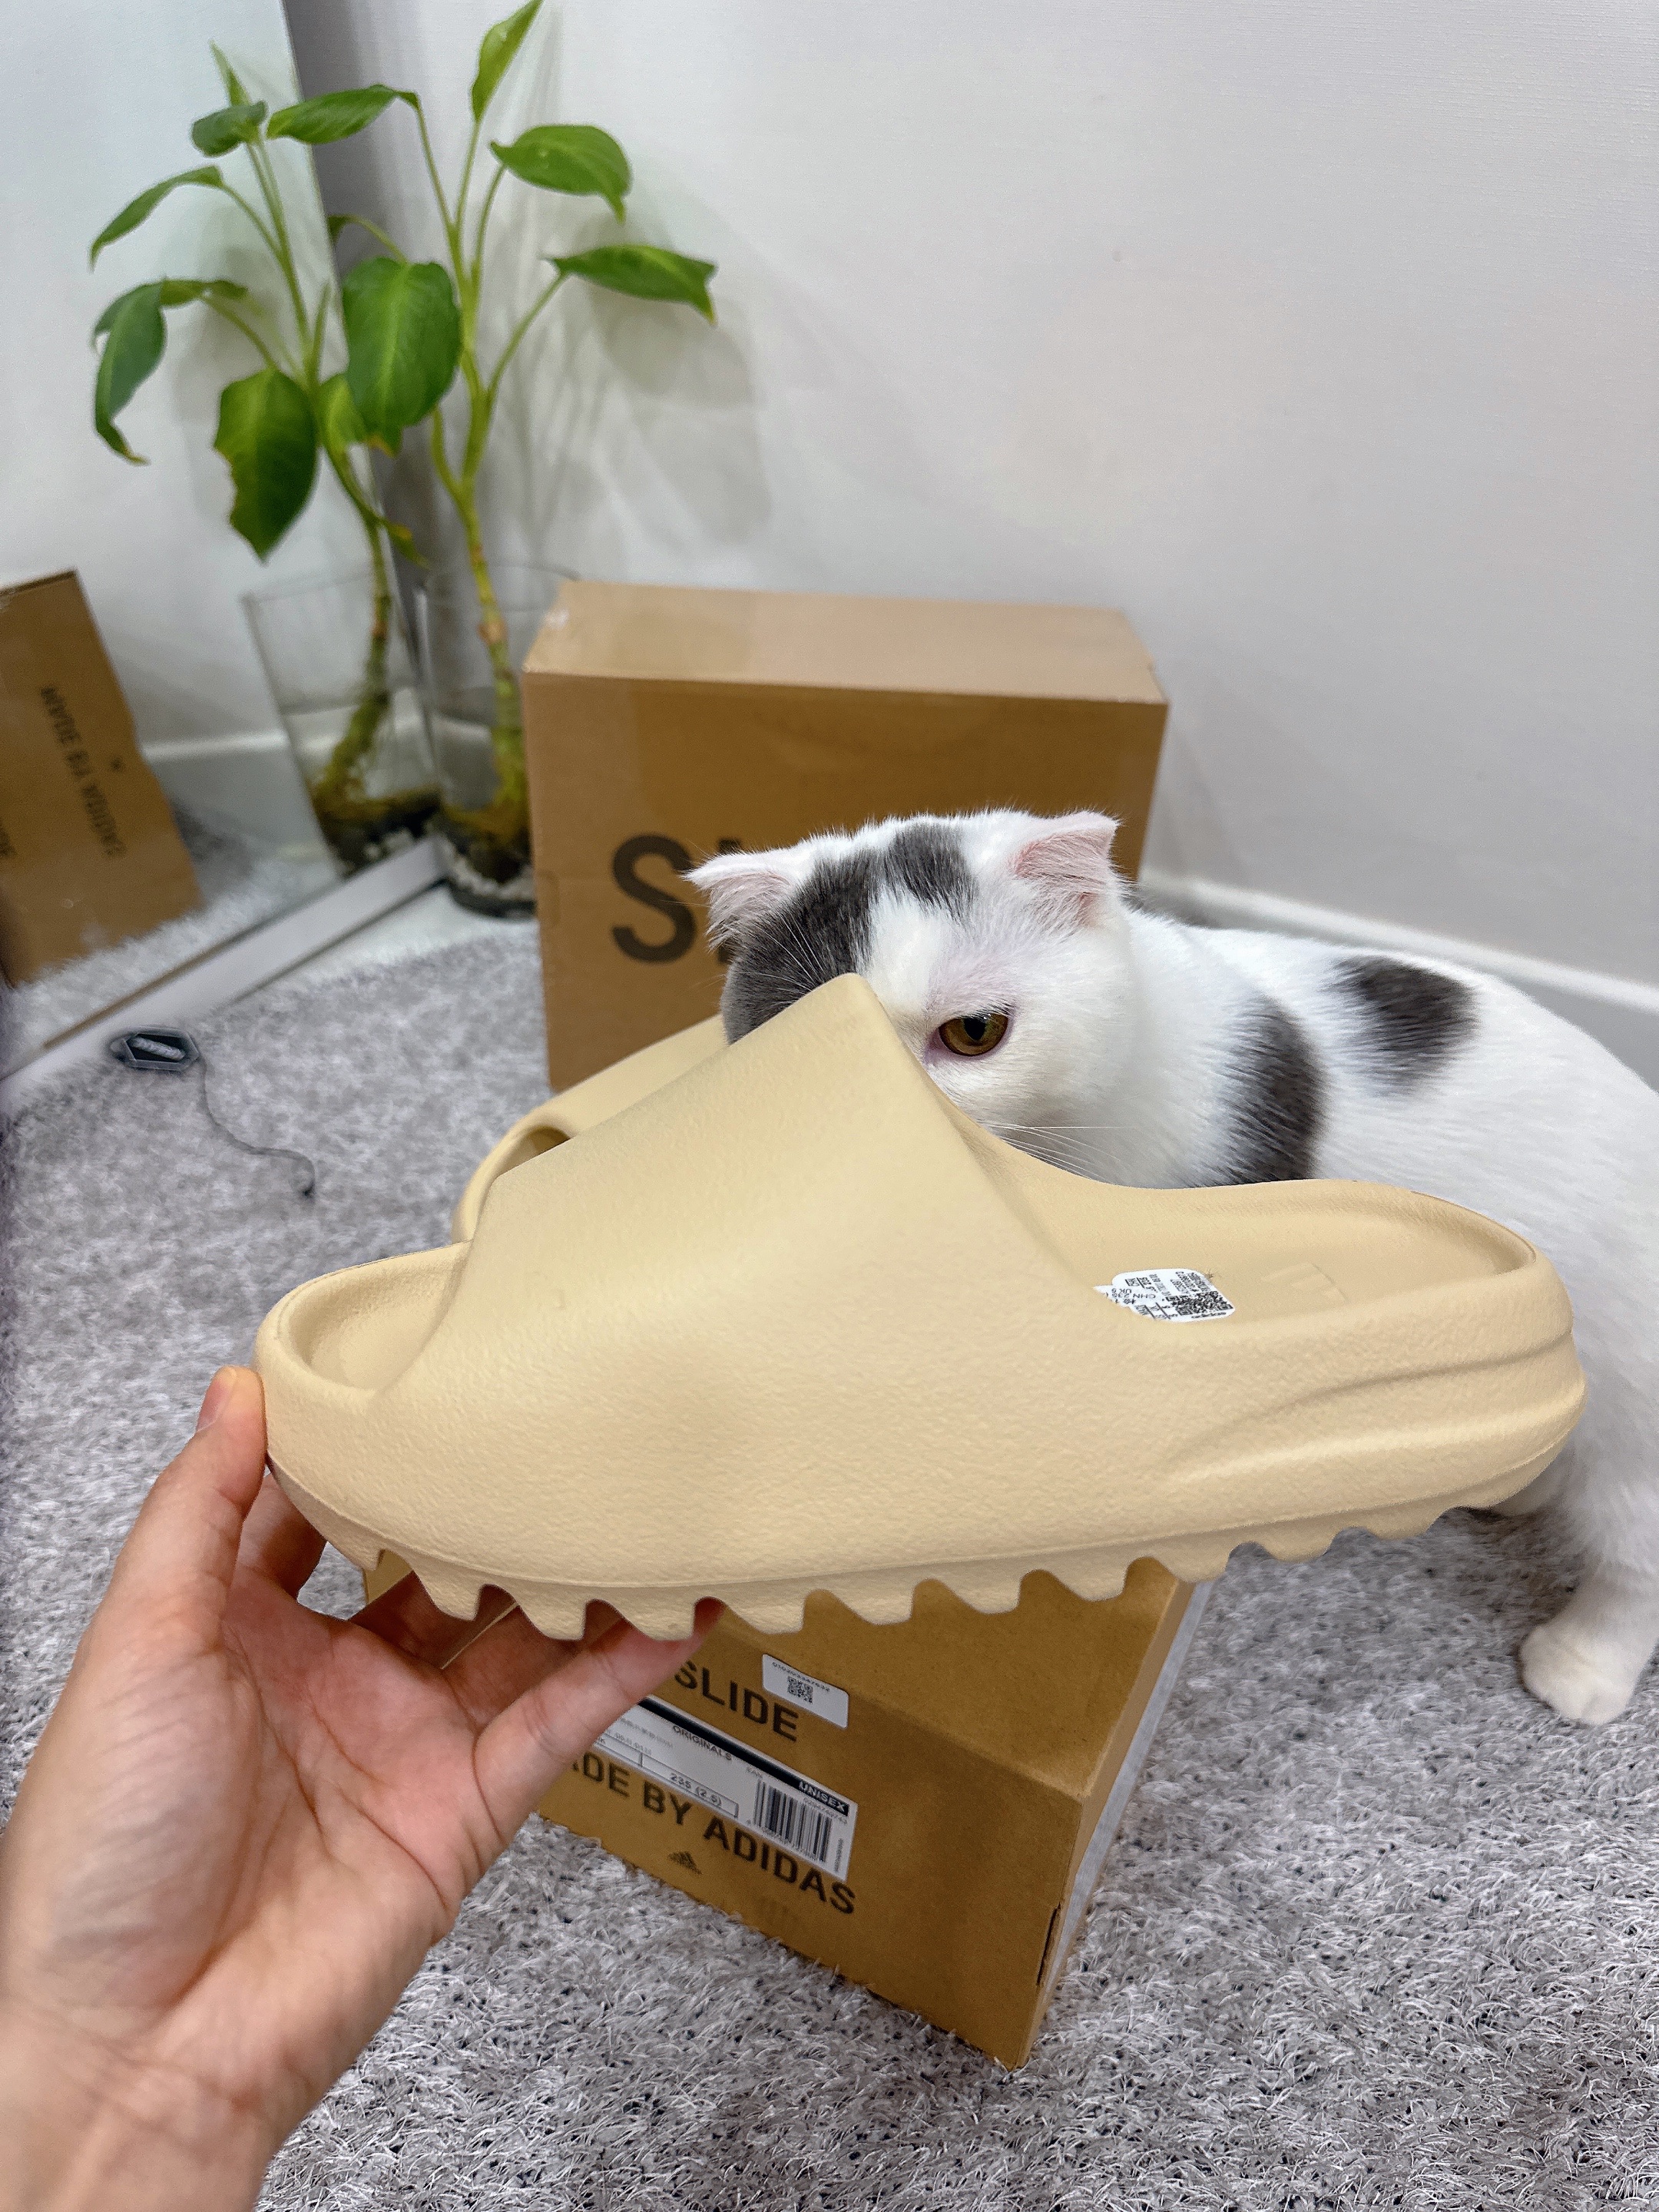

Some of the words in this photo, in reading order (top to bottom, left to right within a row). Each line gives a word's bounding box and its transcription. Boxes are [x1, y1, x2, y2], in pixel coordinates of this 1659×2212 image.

[674, 1660, 799, 1743] SLIDE
[672, 1724, 733, 1761] ORIGINALS
[670, 1772, 693, 1790] 235
[798, 1780, 846, 1813] UNISEX
[571, 1752, 631, 1798] DE
[642, 1780, 693, 1826] BY
[703, 1816, 856, 1915] ADIDAS
